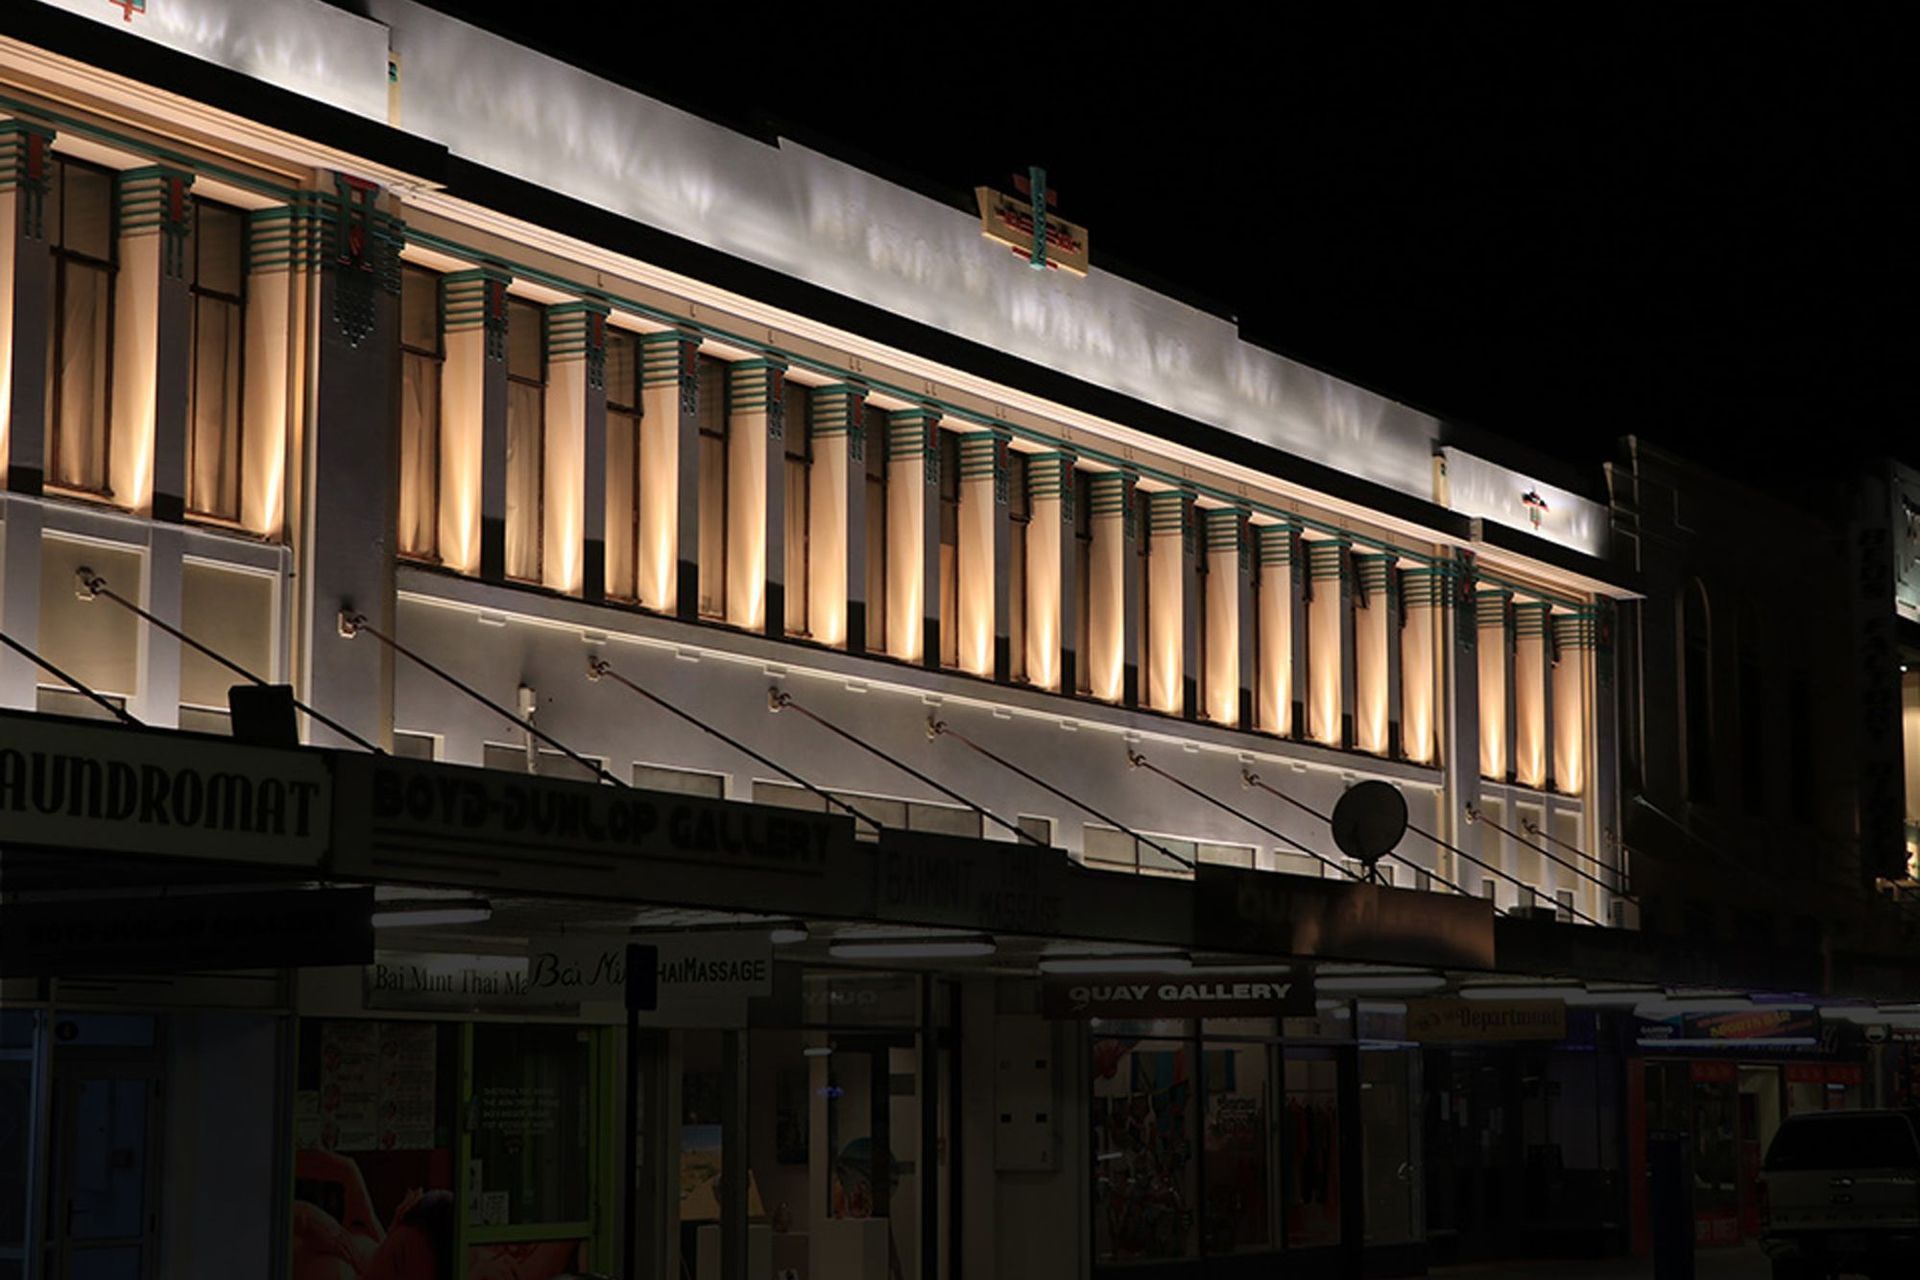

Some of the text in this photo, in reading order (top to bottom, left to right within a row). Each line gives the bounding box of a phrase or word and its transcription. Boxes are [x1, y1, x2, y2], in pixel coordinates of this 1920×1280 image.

[668, 804, 832, 864] GALLERY
[375, 965, 404, 991] Bai
[410, 966, 455, 993] Mint
[462, 969, 500, 994] Thai
[530, 952, 582, 988] Bai
[1068, 981, 1293, 1013] QUAY GALLERY
[1456, 1005, 1560, 1033] Department
